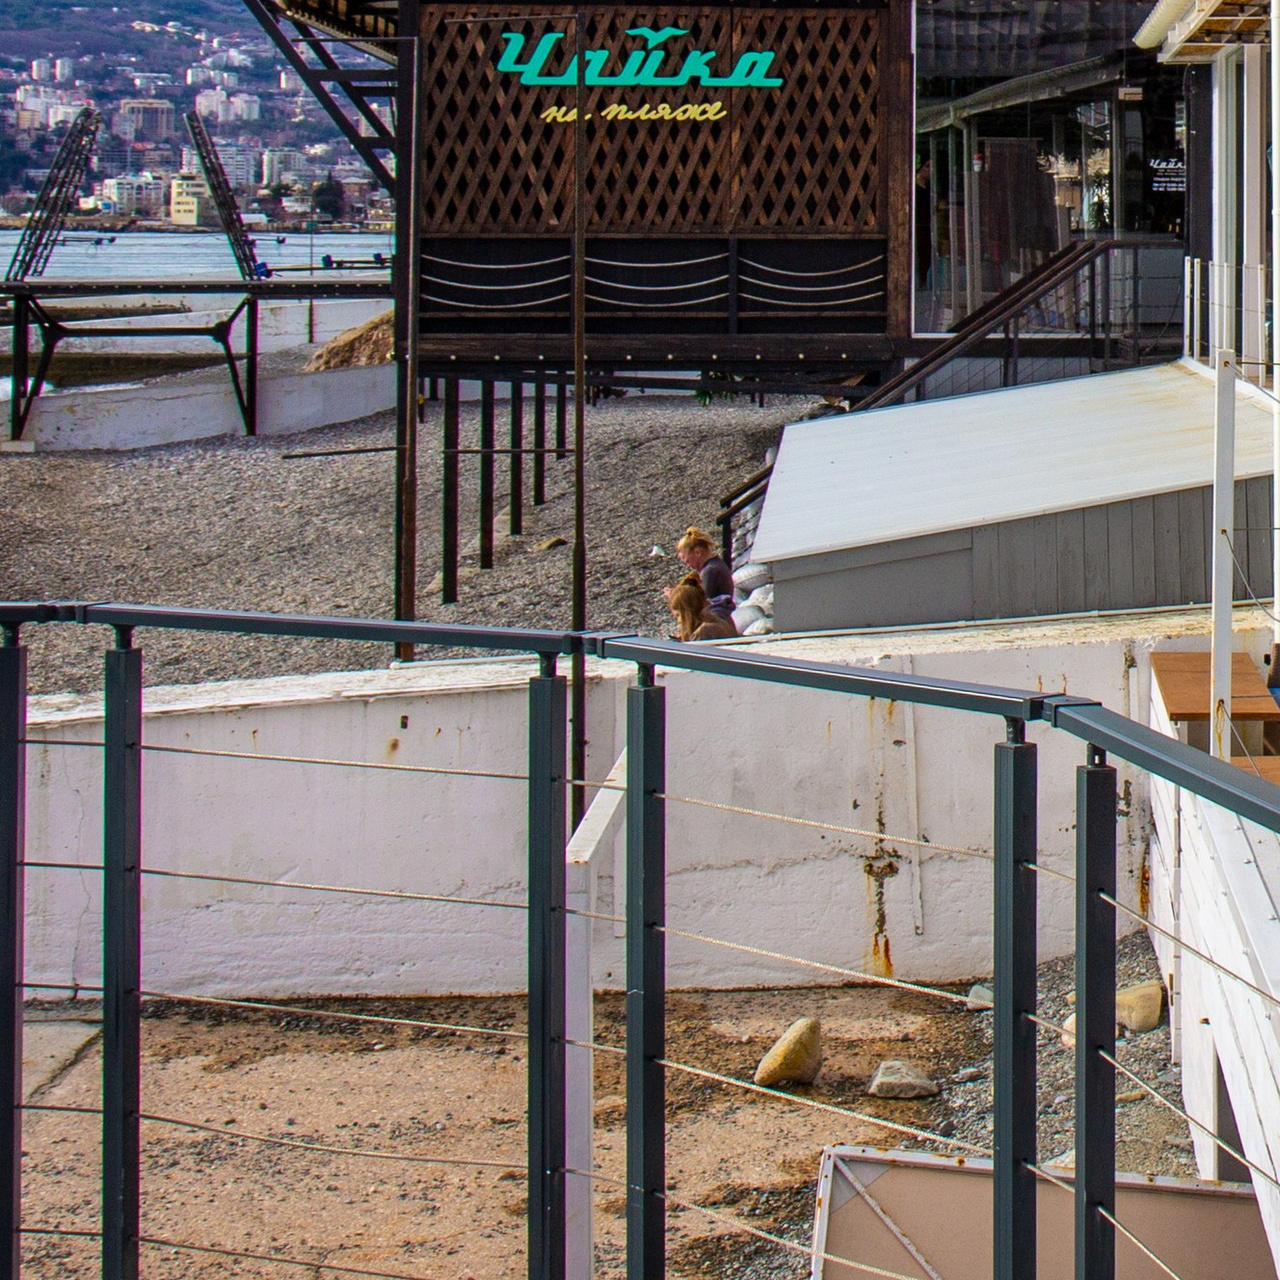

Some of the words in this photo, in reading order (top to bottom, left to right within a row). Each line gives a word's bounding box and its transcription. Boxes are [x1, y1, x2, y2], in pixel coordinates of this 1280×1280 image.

[497, 26, 783, 86] Чайка
[601, 101, 727, 121] пляже
[1149, 158, 1186, 169] Чайк
